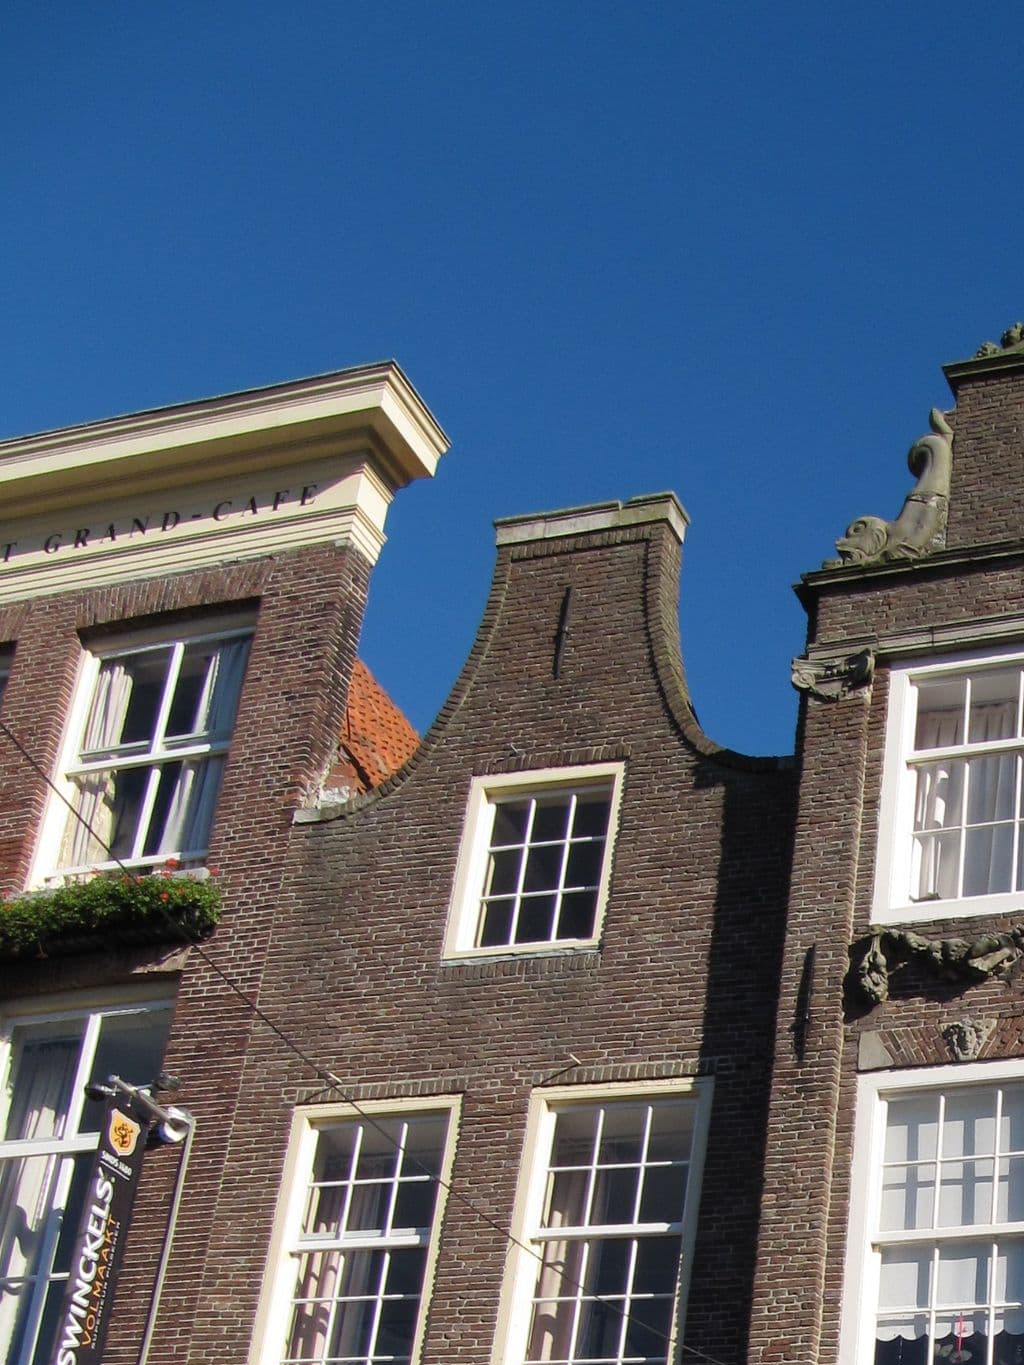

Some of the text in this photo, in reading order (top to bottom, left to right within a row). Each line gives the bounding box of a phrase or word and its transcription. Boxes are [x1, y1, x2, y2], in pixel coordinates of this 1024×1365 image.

[81, 1214, 117, 1347] VOLMAAKT
[90, 1220, 121, 1350] SUPERIEUR PILSENER
